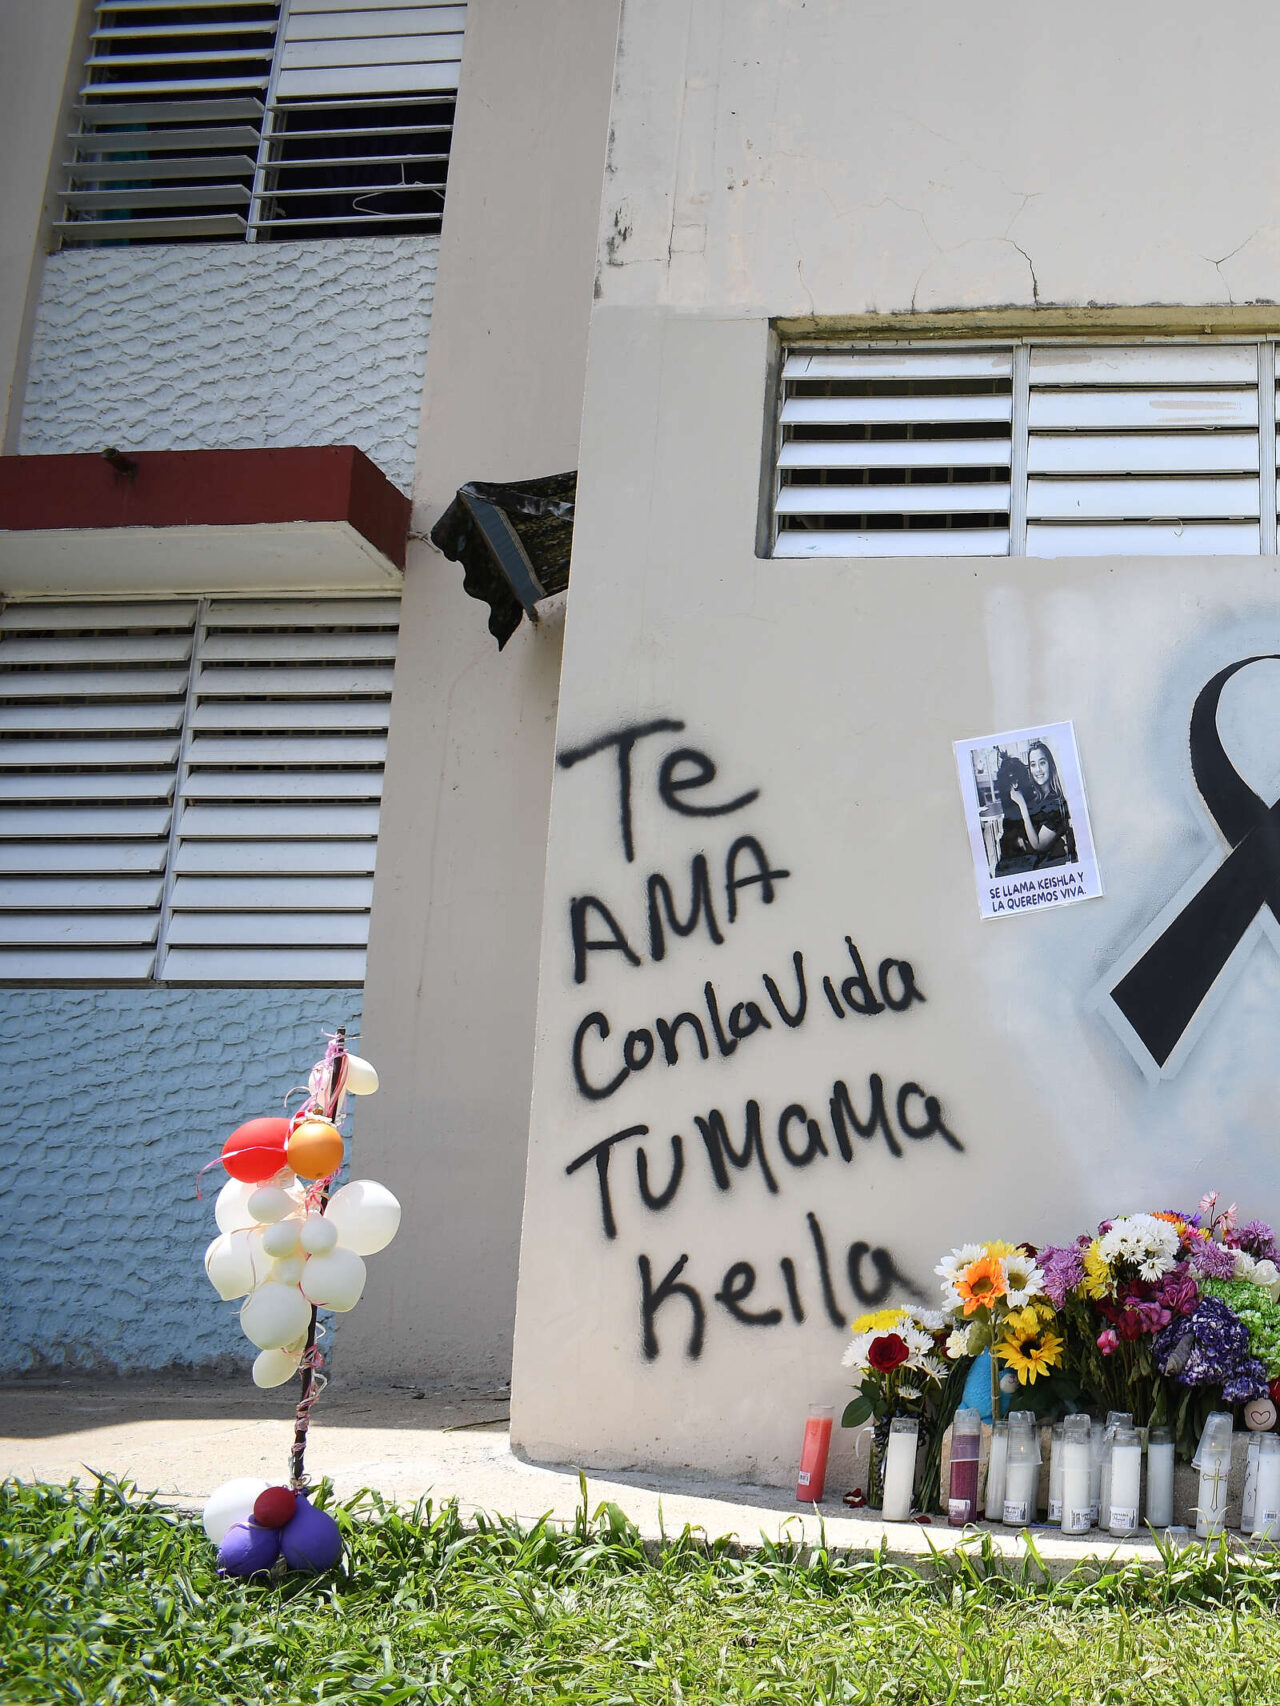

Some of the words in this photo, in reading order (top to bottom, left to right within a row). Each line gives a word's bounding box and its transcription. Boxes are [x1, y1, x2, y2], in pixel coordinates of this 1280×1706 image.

[557, 716, 762, 863] Te
[570, 835, 791, 984] AMA
[989, 887, 1000, 899] SE
[1003, 880, 1035, 897] LLAMA
[1037, 873, 1076, 890] KEISHLA
[1077, 872, 1084, 882] Y
[992, 901, 1005, 912] LA
[1007, 890, 1058, 910] QUEREMOS
[1060, 885, 1087, 899] VIVA.
[638, 1211, 930, 1359] Keila
